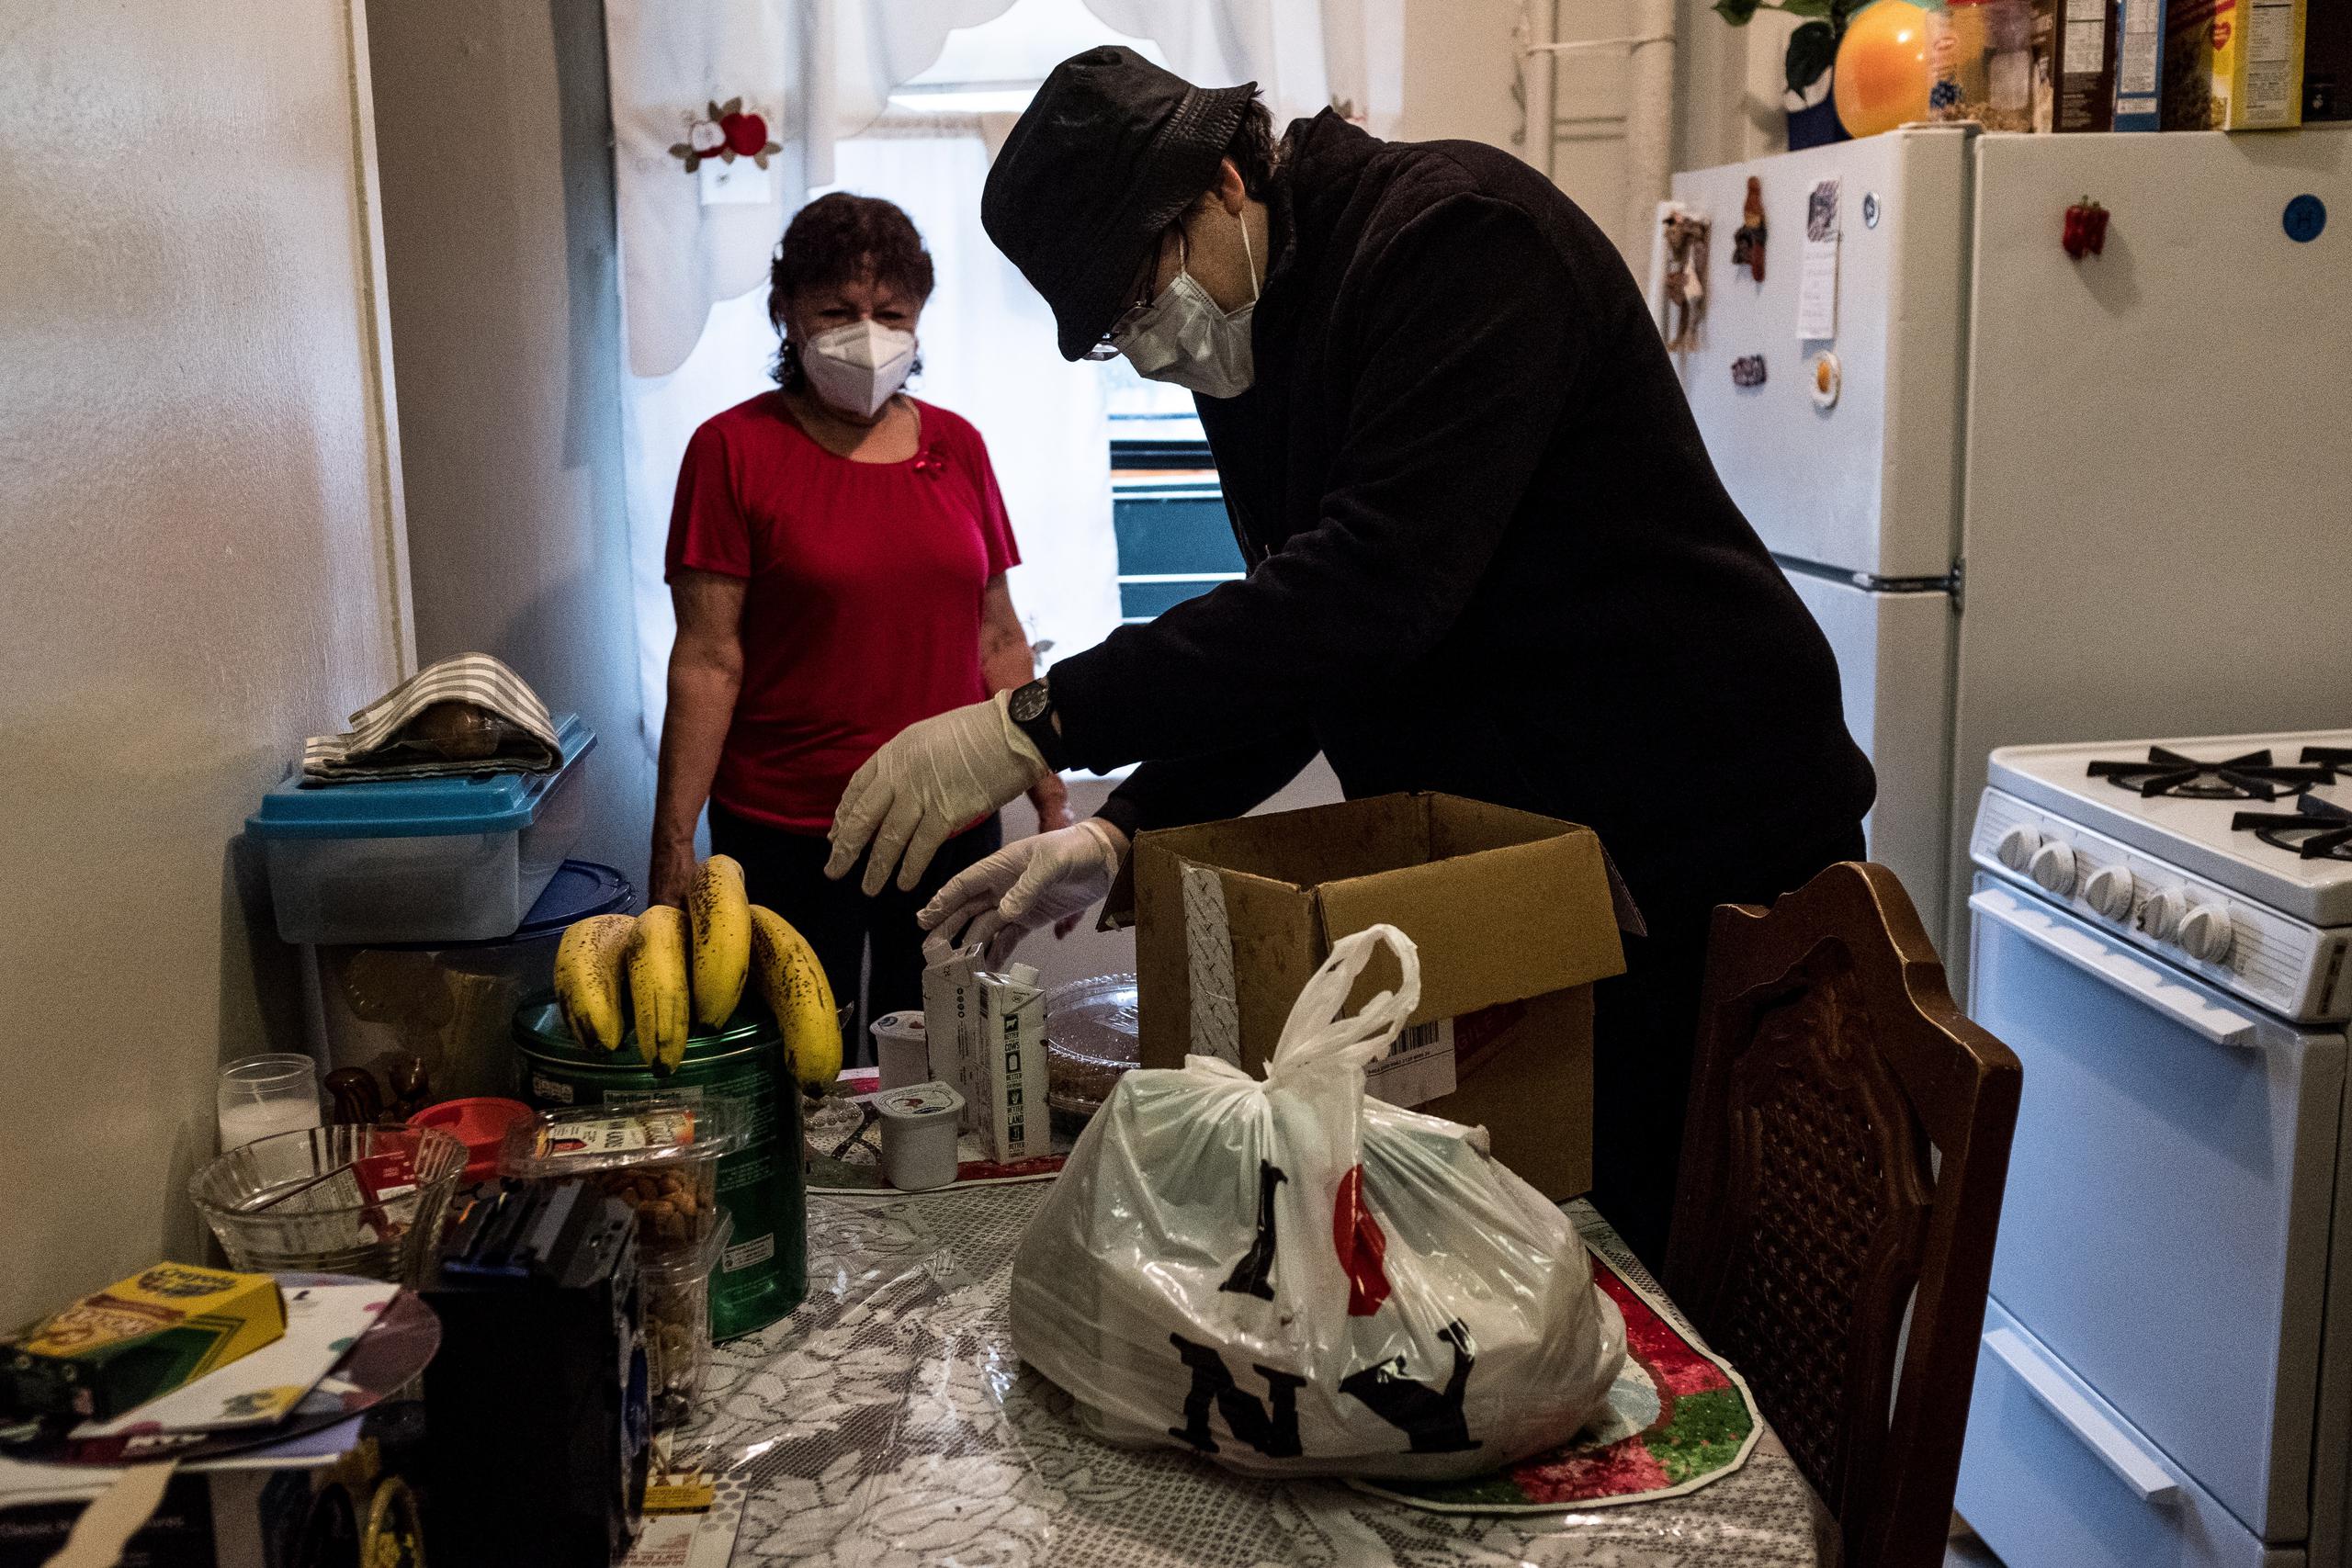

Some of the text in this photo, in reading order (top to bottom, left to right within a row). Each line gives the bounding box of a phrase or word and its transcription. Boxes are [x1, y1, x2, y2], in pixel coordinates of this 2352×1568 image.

[1004, 1032, 1019, 1041] BETTER
[1004, 1041, 1020, 1052] COWS
[1006, 1073, 1022, 1081] BETTER
[606, 1091, 681, 1103] Nutrition Facts
[1007, 1105, 1023, 1113] BETTER
[1007, 1114, 1024, 1125] LAND
[1008, 1141, 1025, 1149] BETTER
[1218, 1159, 1288, 1302] I
